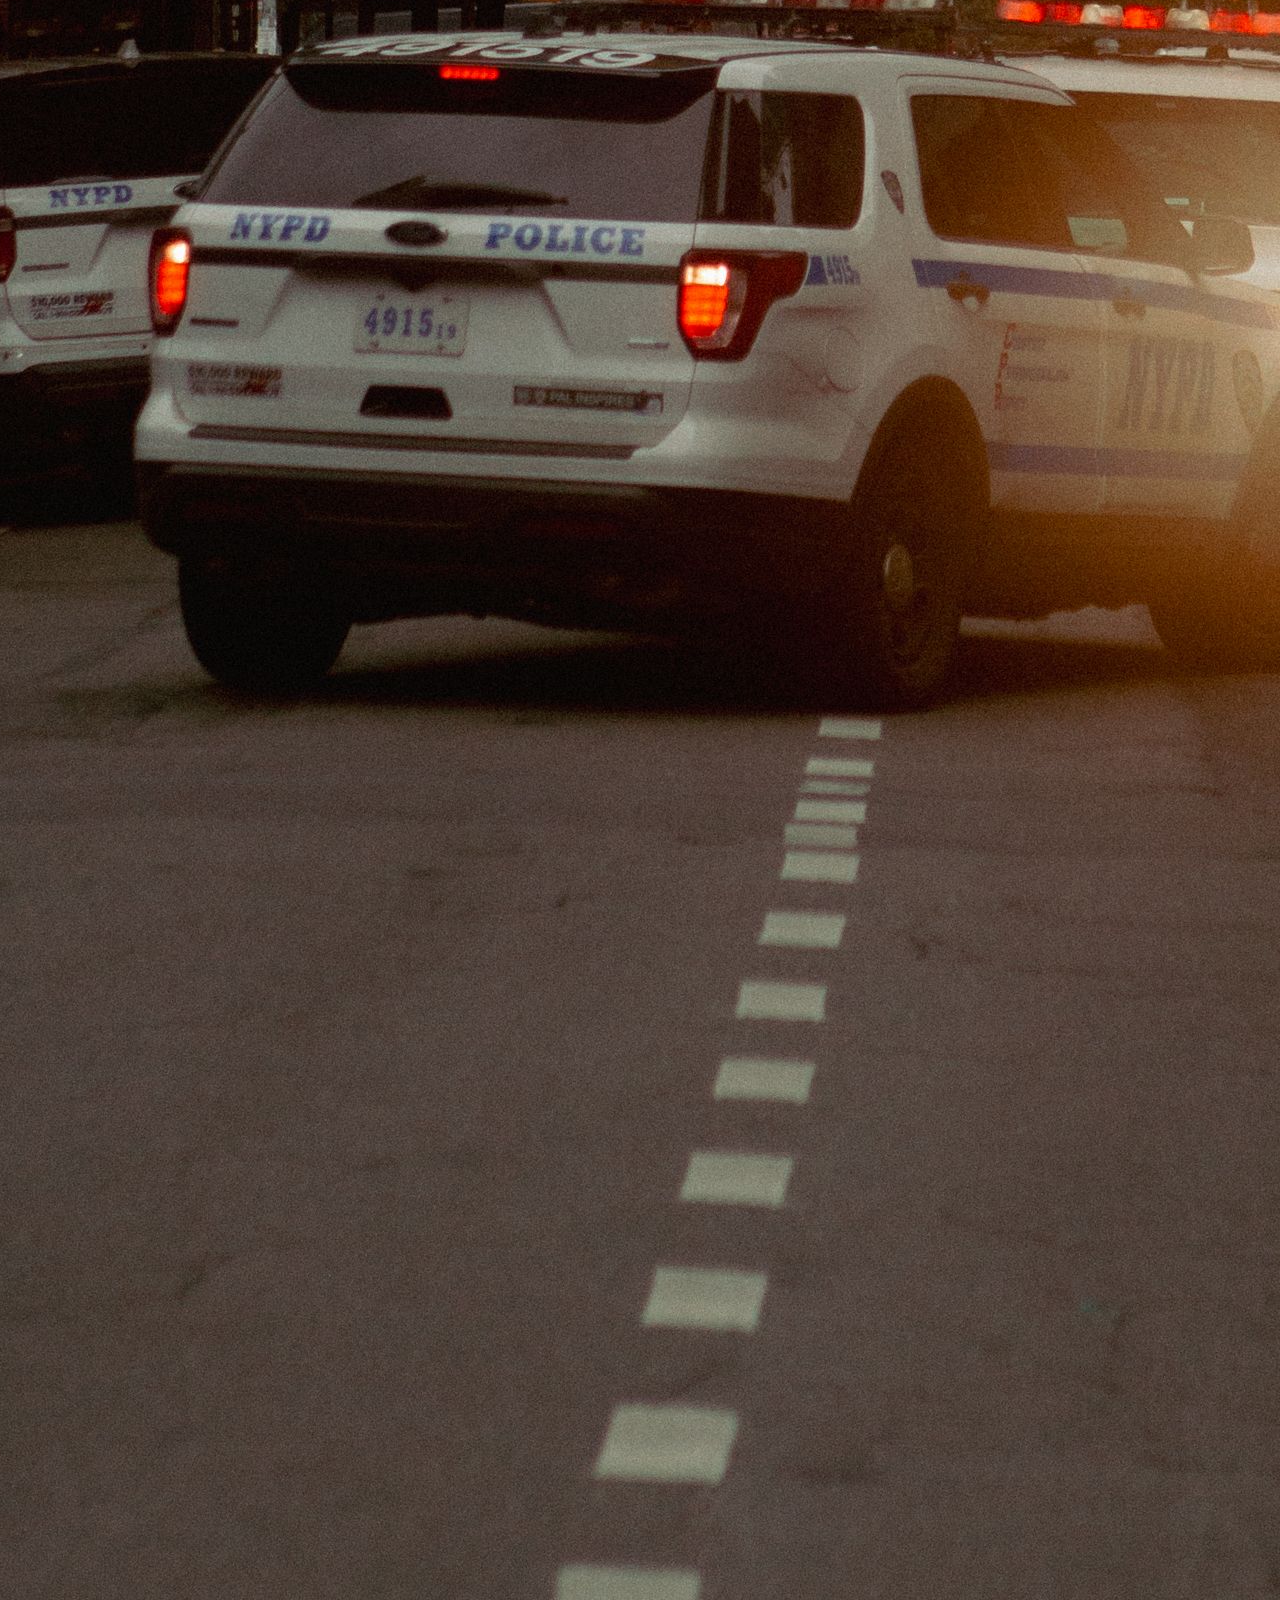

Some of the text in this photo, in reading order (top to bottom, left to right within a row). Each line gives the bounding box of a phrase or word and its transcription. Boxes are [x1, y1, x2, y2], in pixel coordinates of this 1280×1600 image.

[49, 185, 133, 208] NYPD
[230, 213, 645, 256] NYPD POLICE
[364, 307, 433, 338] 4915
